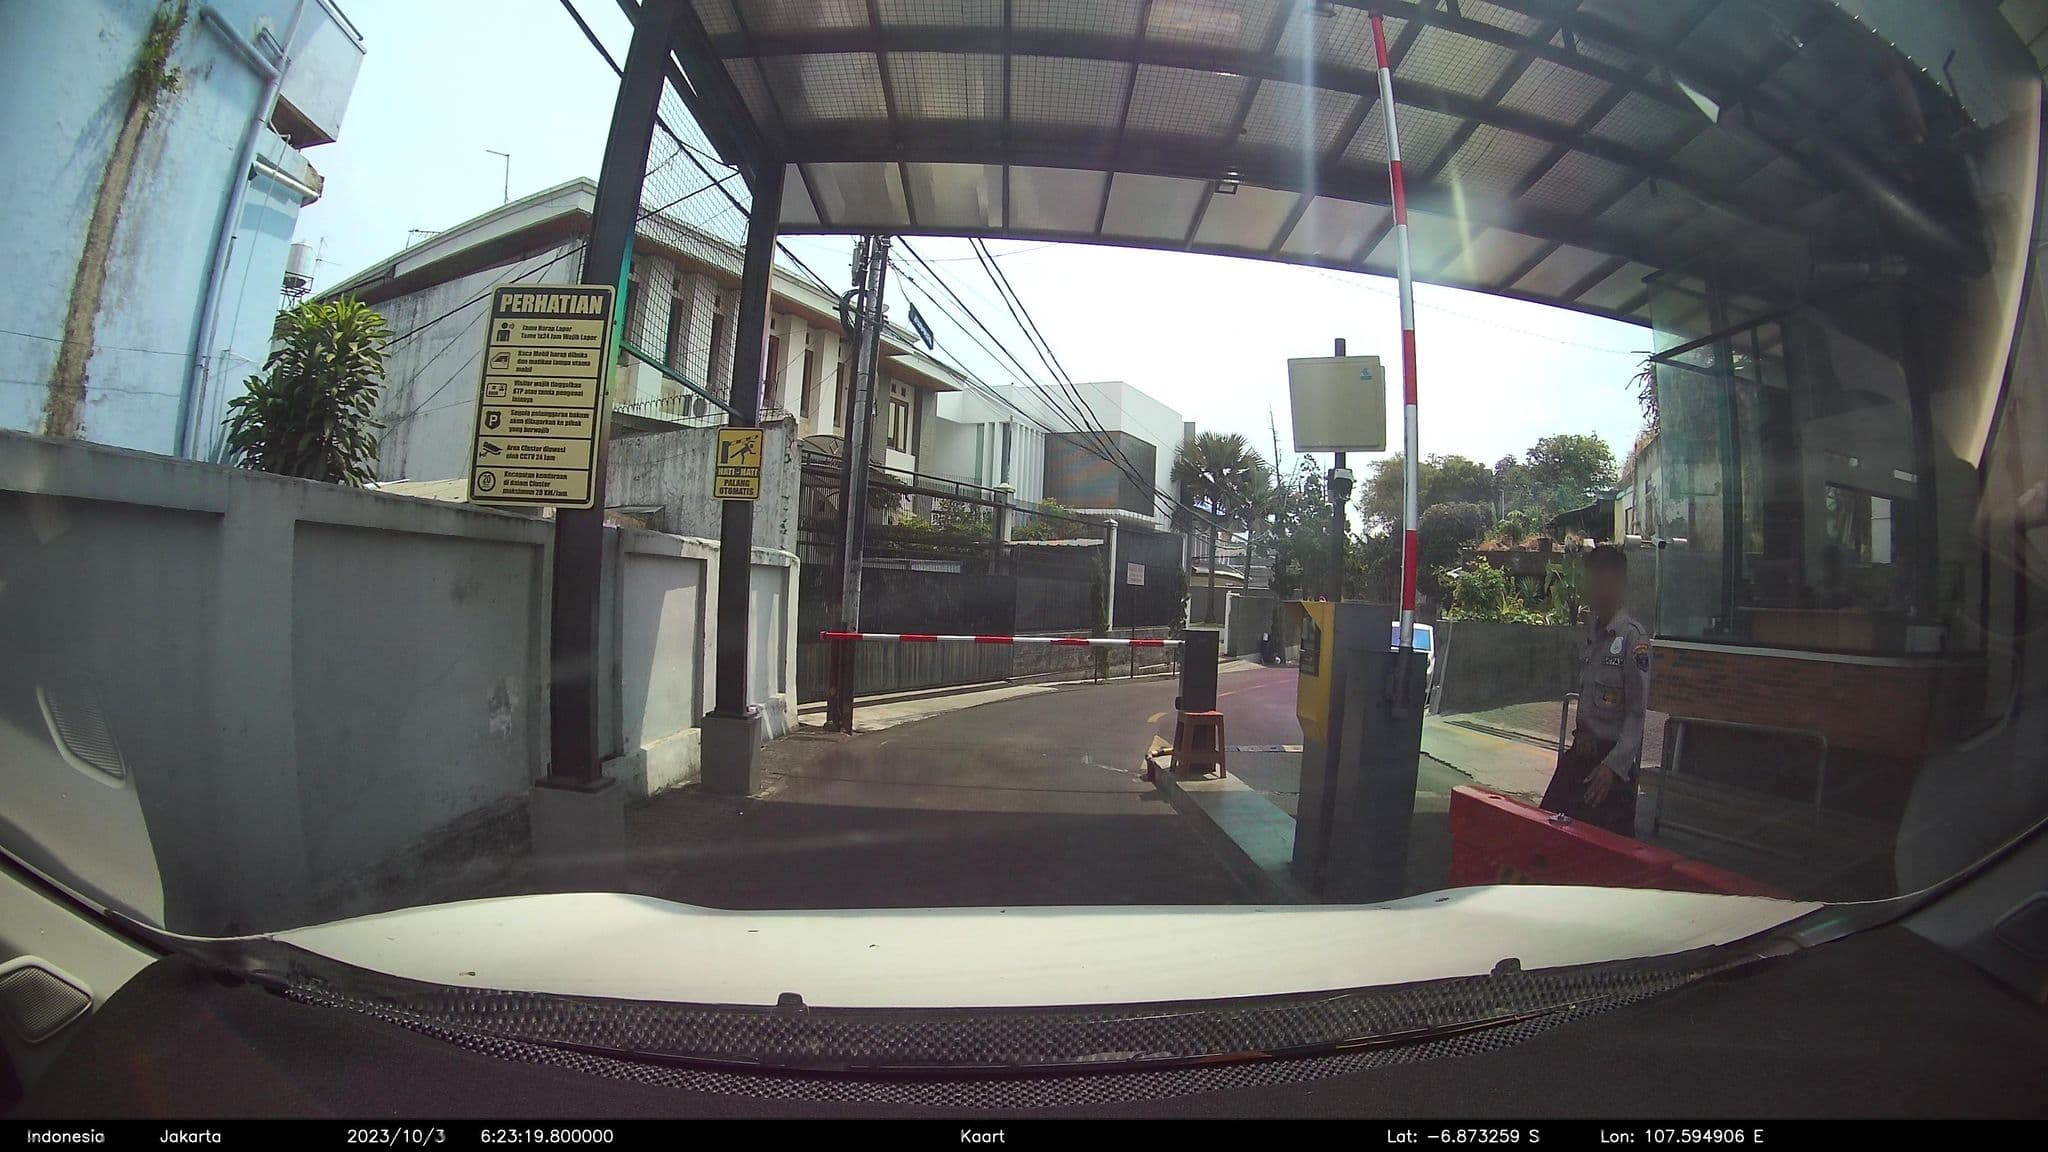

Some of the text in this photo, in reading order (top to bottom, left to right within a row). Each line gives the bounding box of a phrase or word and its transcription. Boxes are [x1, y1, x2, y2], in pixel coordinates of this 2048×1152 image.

[500, 294, 603, 314] PERHATIAN
[740, 468, 758, 477] HATI
[724, 479, 750, 488] PALANG
[720, 487, 754, 496] OTOMATIS
